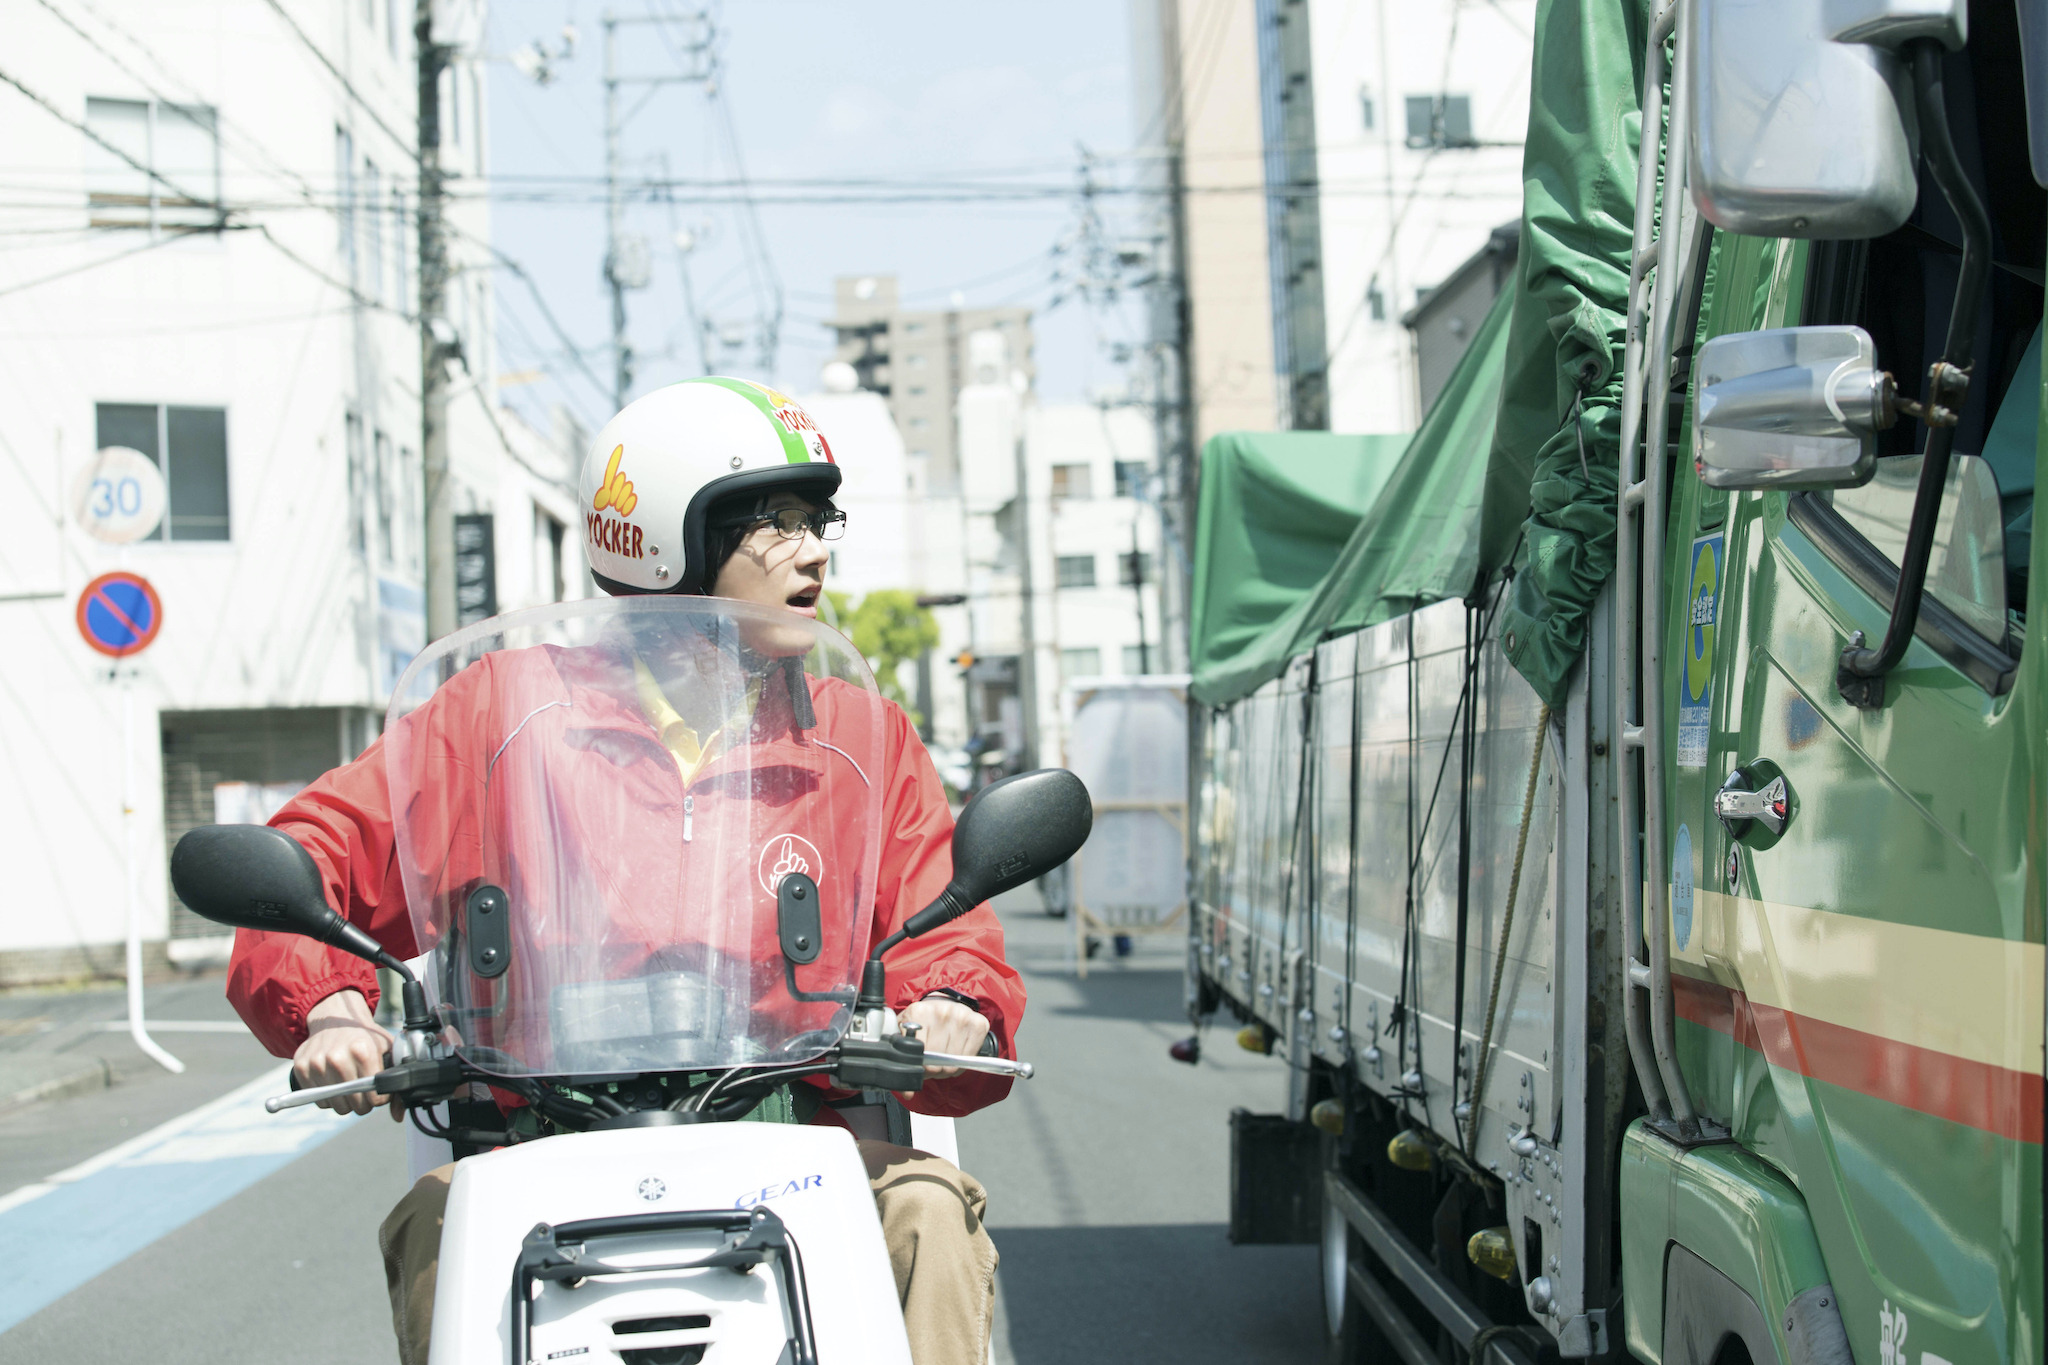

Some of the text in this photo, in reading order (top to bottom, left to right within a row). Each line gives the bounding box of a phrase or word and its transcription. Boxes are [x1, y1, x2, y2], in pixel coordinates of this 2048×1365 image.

[774, 409, 817, 432] YOCKE
[93, 476, 141, 518] 30
[587, 511, 644, 560] YOCKER
[734, 1174, 822, 1209] GEAR
